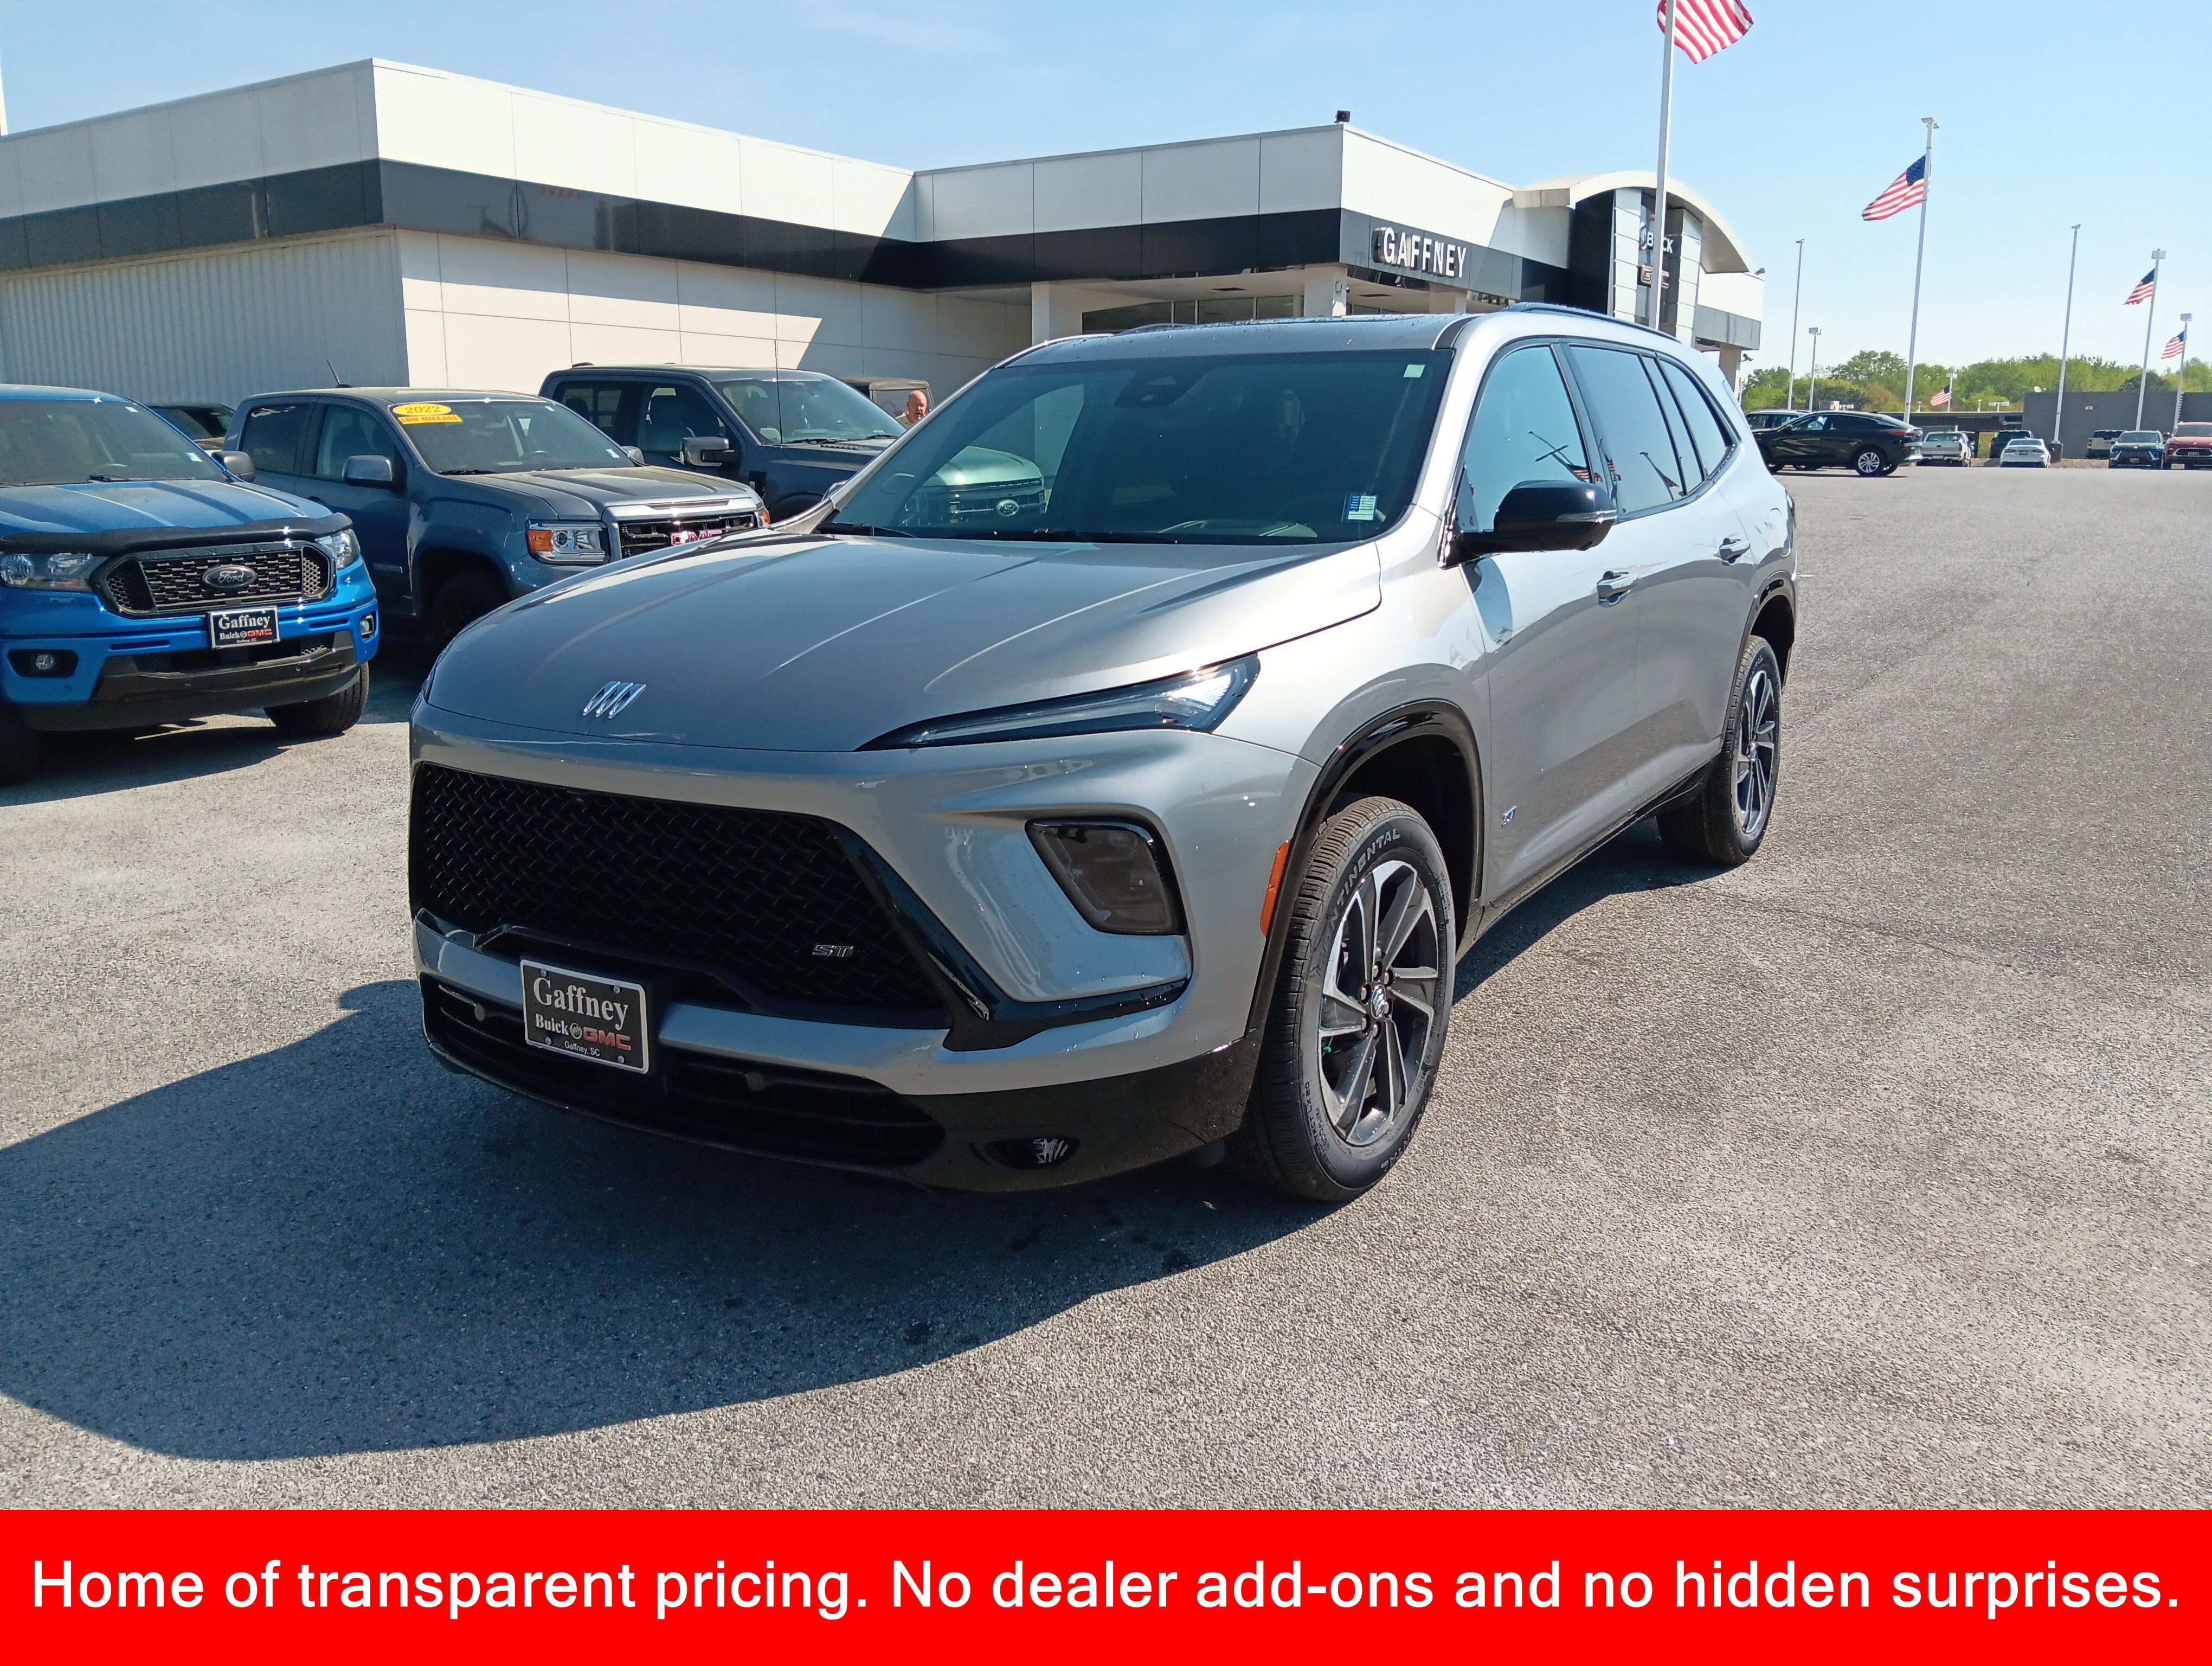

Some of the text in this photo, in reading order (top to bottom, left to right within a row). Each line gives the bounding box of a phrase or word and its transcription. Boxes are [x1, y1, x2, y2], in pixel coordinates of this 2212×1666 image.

[1383, 227, 1467, 278] GAFFNEY
[405, 406, 441, 414] 2022
[218, 570, 245, 584] Ford
[218, 614, 271, 629] Gaffney
[219, 629, 272, 640] Buick GMC
[812, 944, 854, 957] ST
[533, 977, 629, 1030] Gaffney
[535, 1013, 631, 1051] Buick GMC
[590, 1047, 600, 1056] SC
